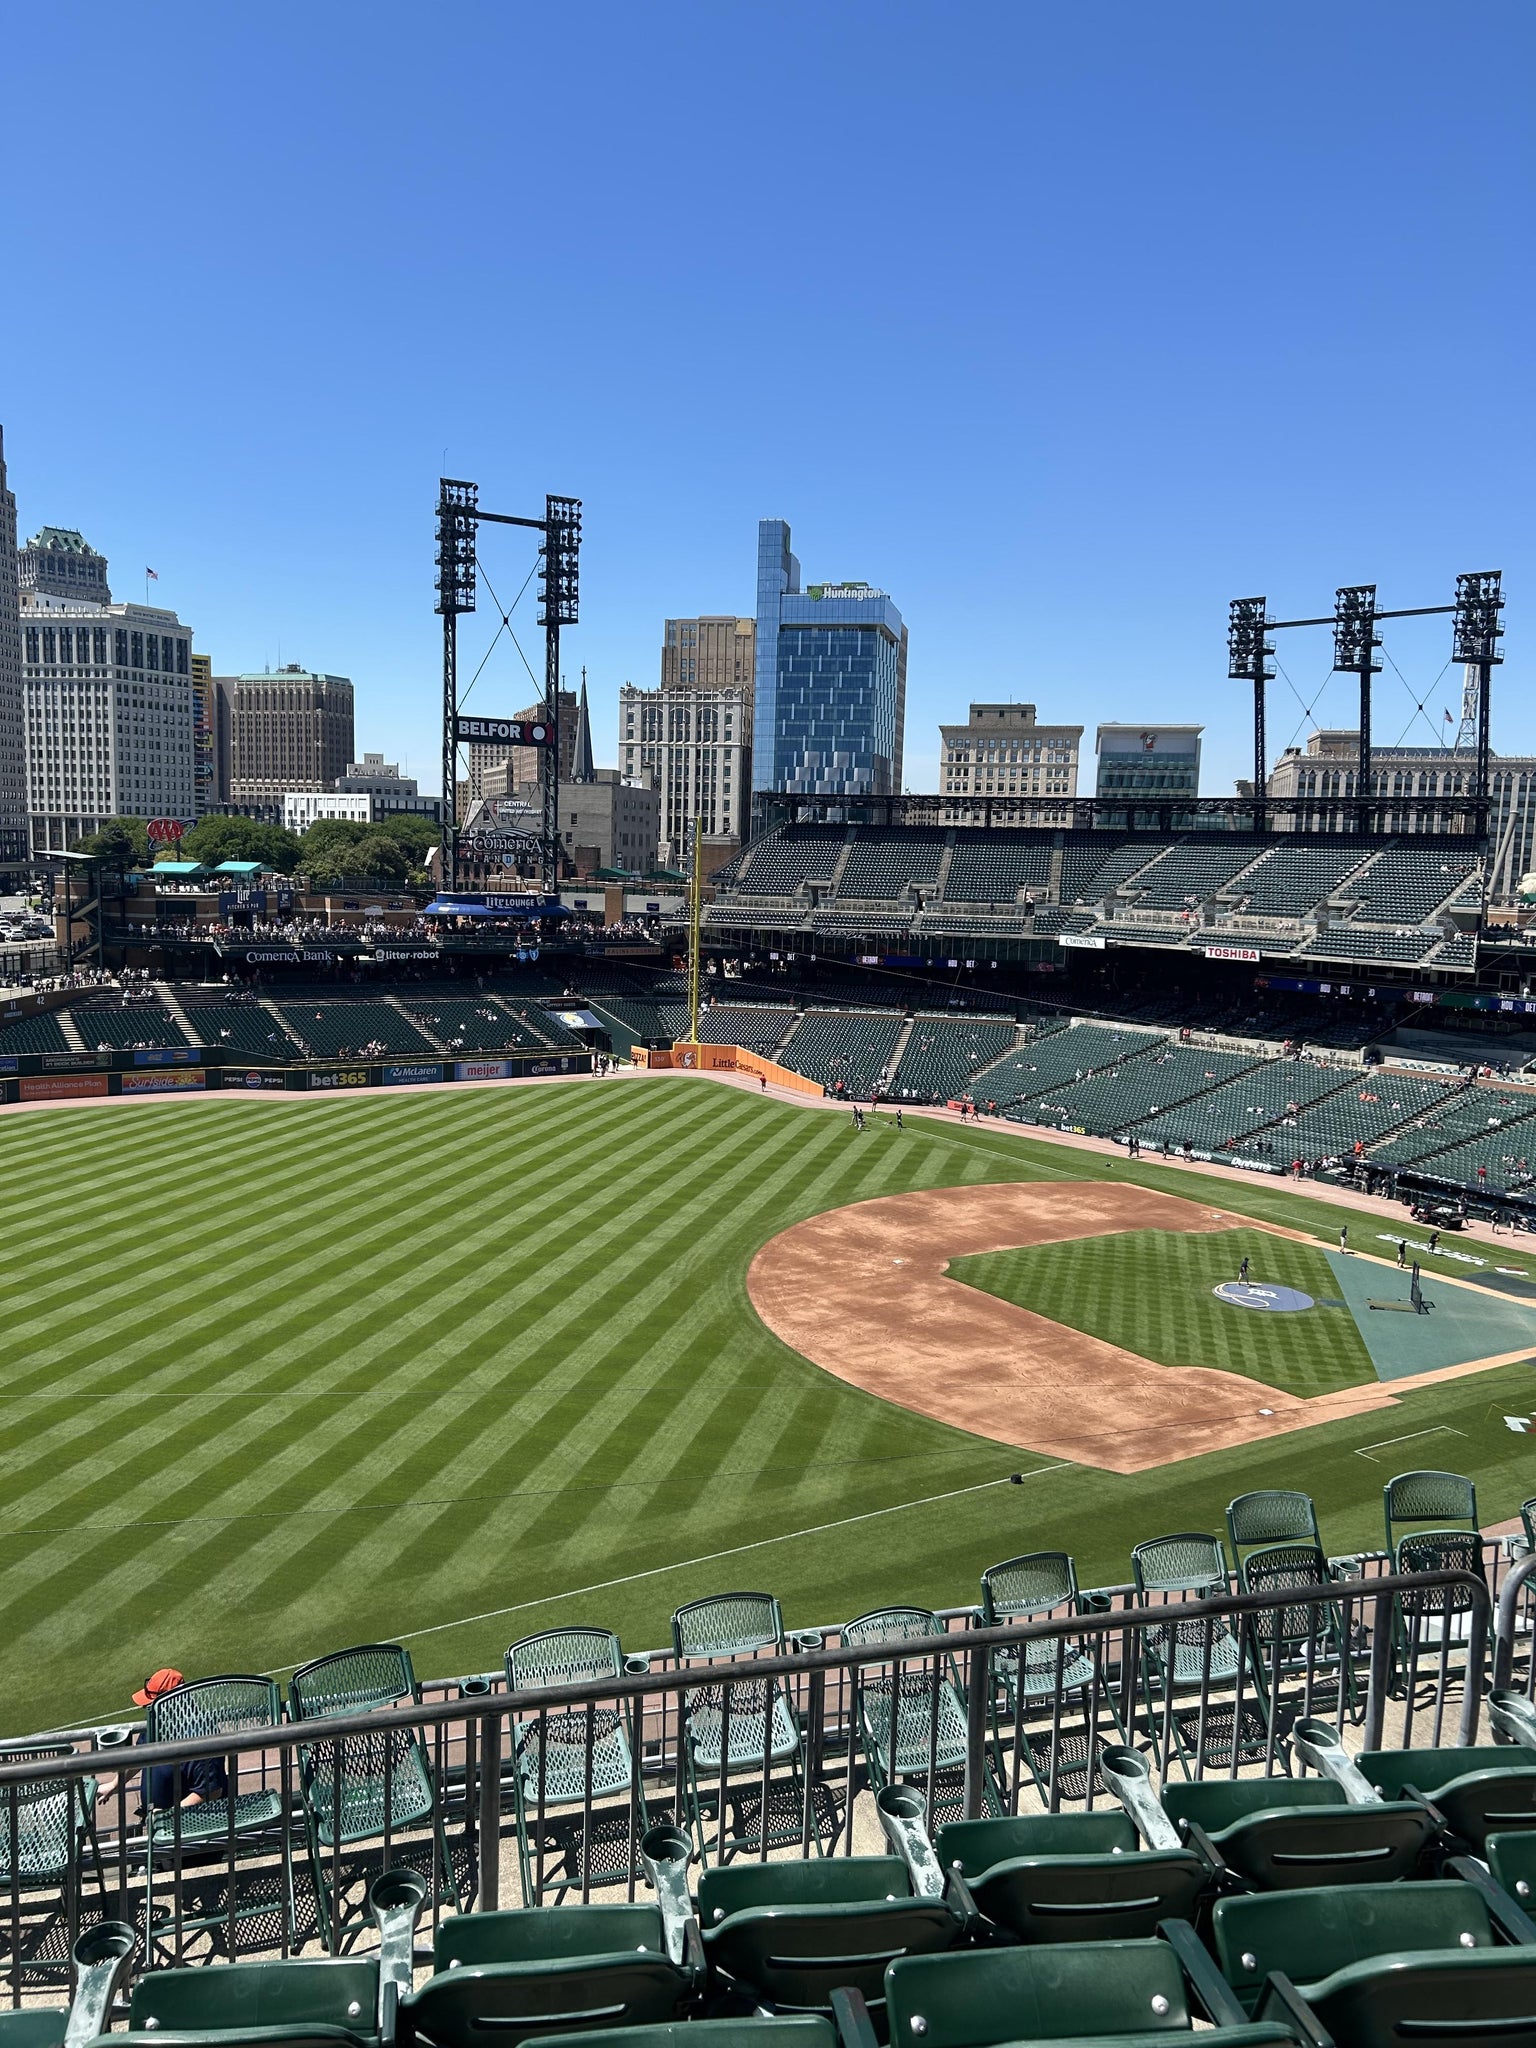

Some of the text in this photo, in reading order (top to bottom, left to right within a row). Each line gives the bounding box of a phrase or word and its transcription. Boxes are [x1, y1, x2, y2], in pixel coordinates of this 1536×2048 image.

[823, 587, 880, 601] Huntington
[458, 721, 520, 739] BELFOR
[151, 820, 181, 840] AAA
[485, 897, 535, 908] Lite LOUNGE
[303, 950, 332, 961] Bank
[1208, 947, 1257, 959] TOSHIBA
[36, 996, 45, 1005] 42
[1413, 992, 1433, 1003] DETROIT
[1501, 1001, 1513, 1010] HOU
[402, 1067, 437, 1075] McLaren
[467, 1064, 500, 1077] meijer
[531, 1065, 556, 1074] Corona
[24, 1079, 102, 1091] Health Alliance Plan
[129, 1076, 174, 1089] Surfside
[311, 1072, 366, 1086] bet365
[1060, 1122, 1086, 1135] bet365
